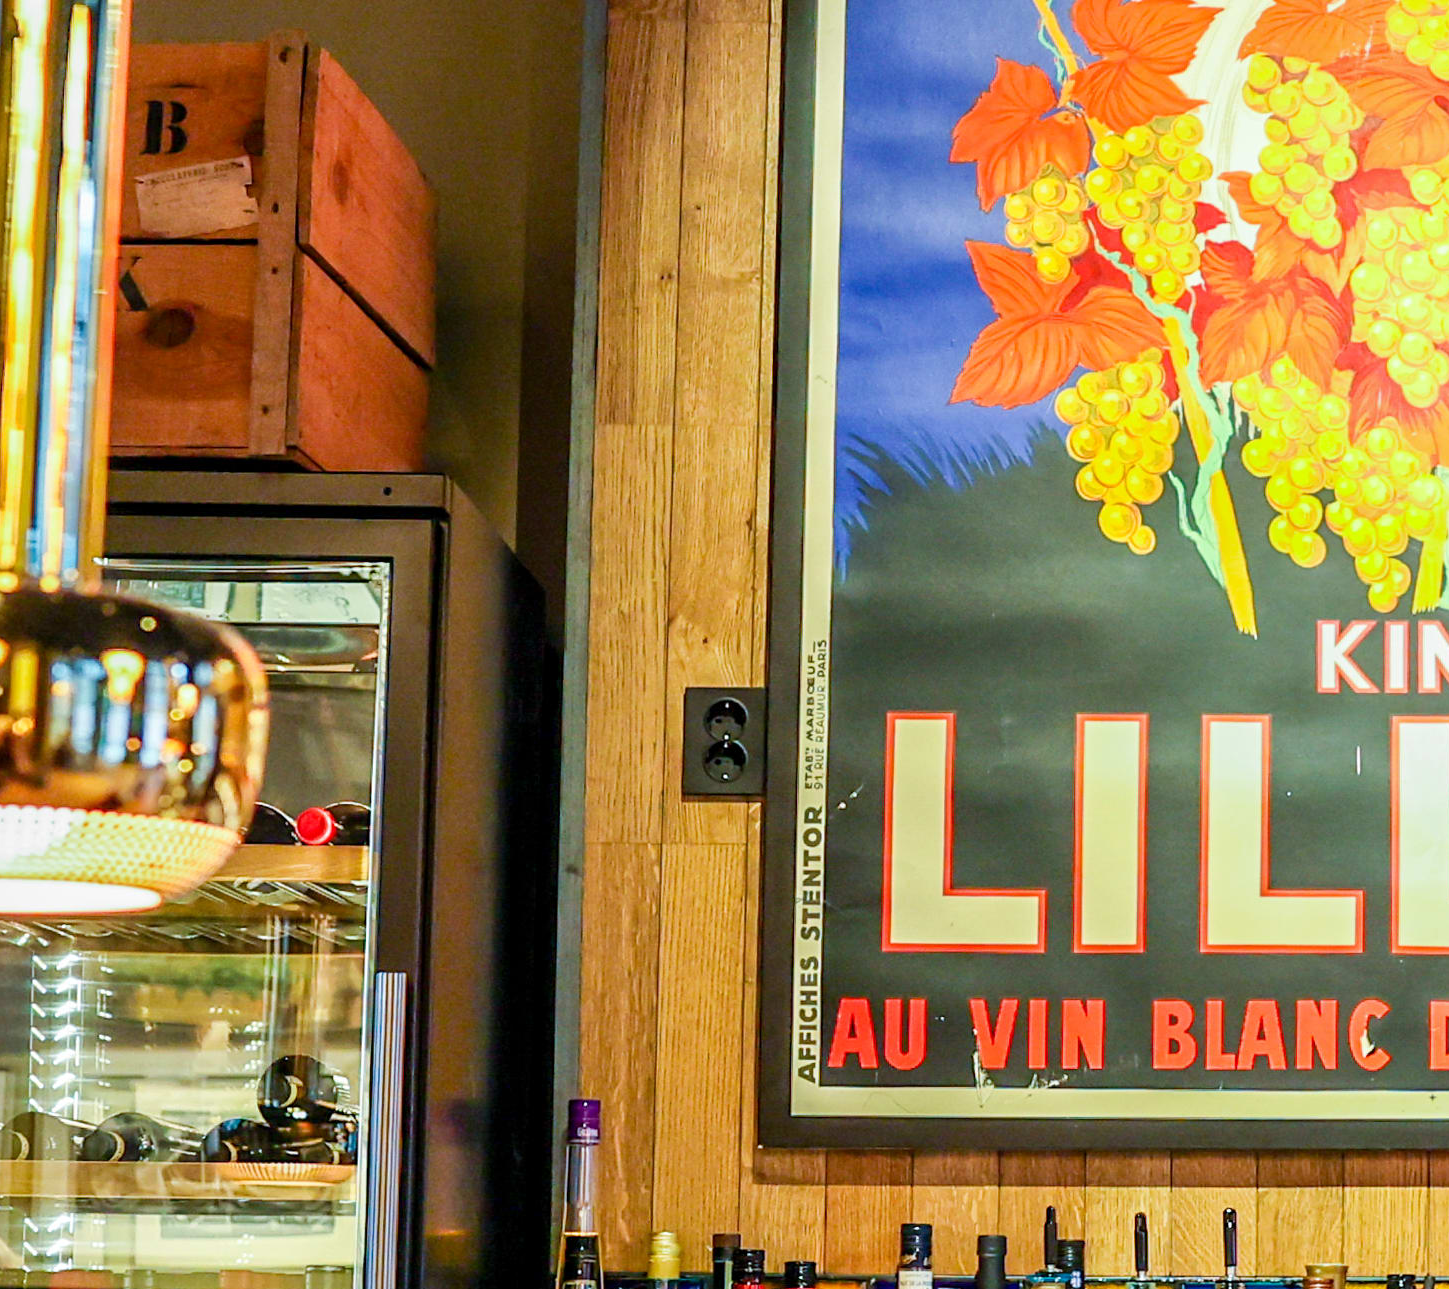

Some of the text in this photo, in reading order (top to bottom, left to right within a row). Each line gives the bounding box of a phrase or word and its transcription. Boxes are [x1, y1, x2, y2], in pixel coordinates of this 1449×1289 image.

[139, 99, 188, 155] B
[816, 639, 827, 678] PARIS
[797, 804, 823, 1084] AFFICHES STENTOR
[826, 995, 927, 1070] AU
[968, 996, 1107, 1072] VIN
[1150, 997, 1395, 1073] BLANC
